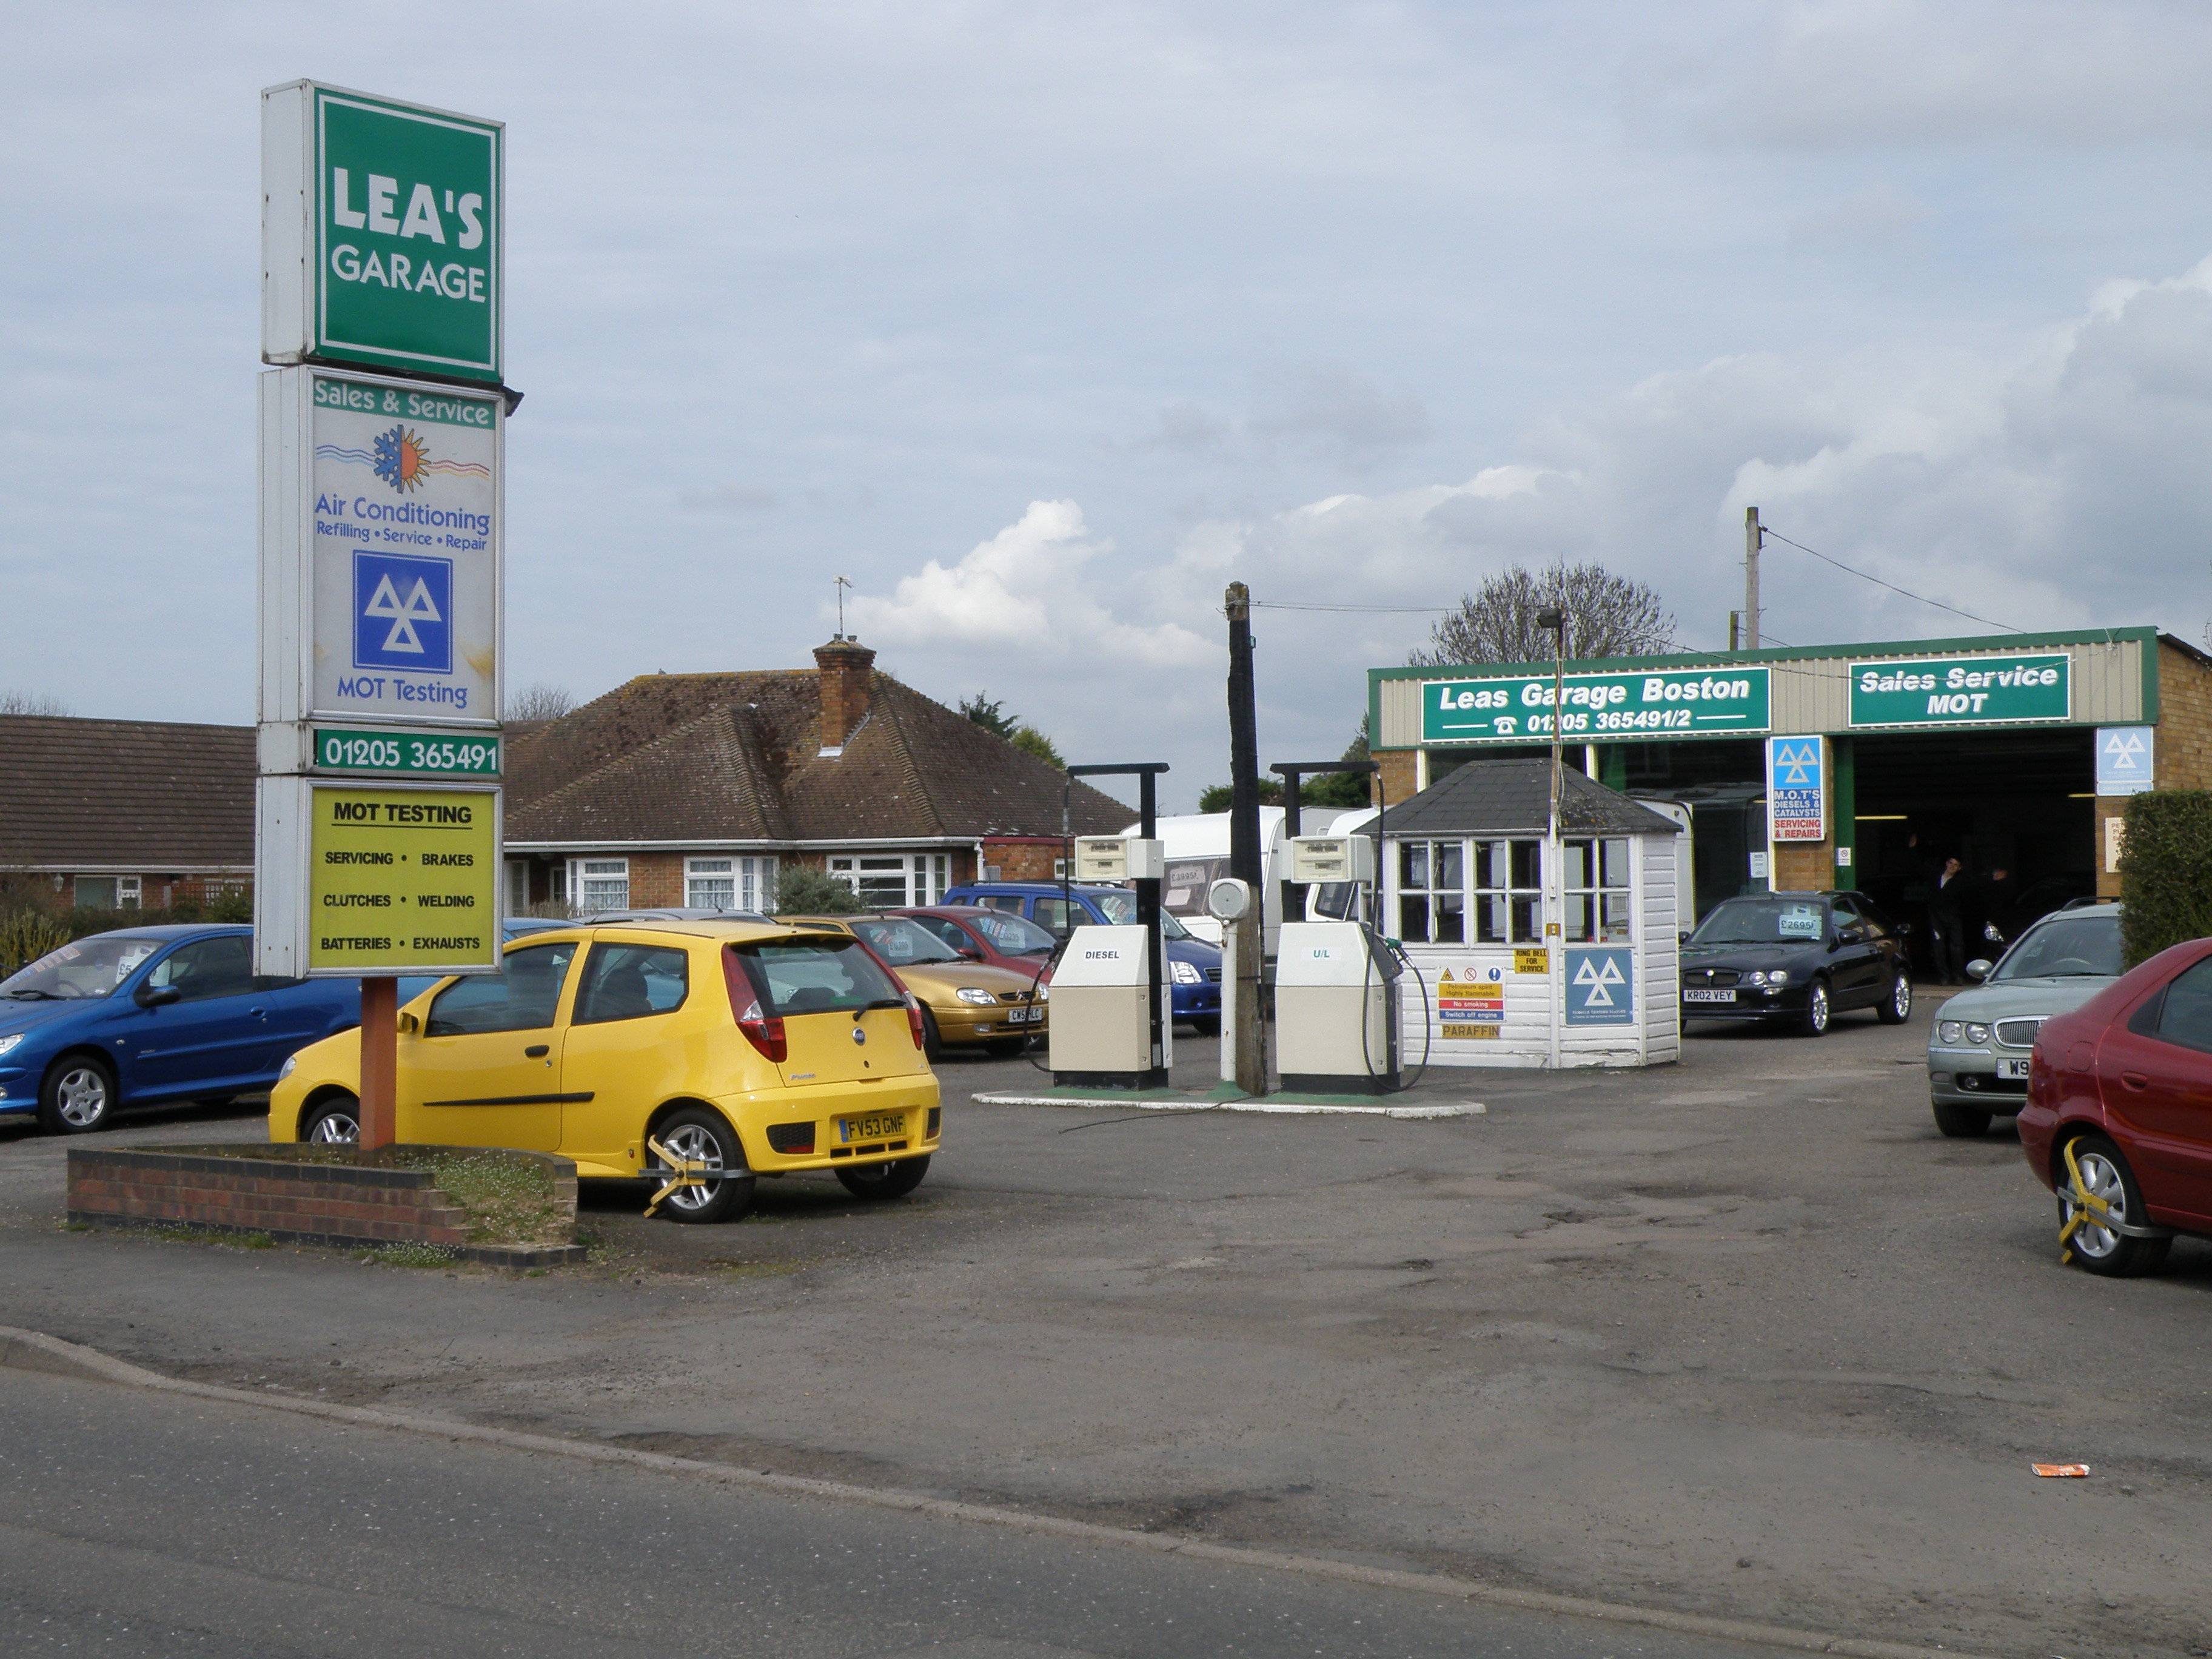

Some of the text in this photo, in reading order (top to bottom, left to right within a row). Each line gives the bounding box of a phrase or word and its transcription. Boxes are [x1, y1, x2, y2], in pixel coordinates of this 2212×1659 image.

[334, 167, 483, 250] LEA'S
[332, 244, 486, 303] GARAGE
[315, 380, 489, 424] Sales & Service
[315, 494, 490, 535] Air Conditioning
[317, 521, 486, 552] Refilling Service Repair
[1860, 665, 2059, 692] Sales Service
[337, 677, 468, 709] MOT Testing
[1439, 677, 1750, 710] Leas Garage Boston
[1927, 693, 1988, 714] MOT
[1595, 709, 1691, 729] 365491/2
[326, 738, 497, 771] 01205 365491
[1774, 789, 1820, 800] M.O.T'S
[334, 803, 472, 823] MOT TESTING
[1774, 808, 1820, 817] CATALYSTS
[1775, 819, 1820, 828] SERVICING
[1785, 830, 1821, 838] REPAIRS
[326, 852, 474, 866] SERVICING BRAKES
[323, 894, 474, 907] CLUTCHES WELDING
[321, 937, 480, 950] BATTERIES EXHAUSTS
[1085, 951, 1119, 959] DIESEL
[1313, 950, 1330, 958] U/L
[1687, 991, 1732, 1000] KR02 VEY
[1443, 1025, 1500, 1036] PARAFFIN
[848, 1116, 903, 1138] FV53 GNF
